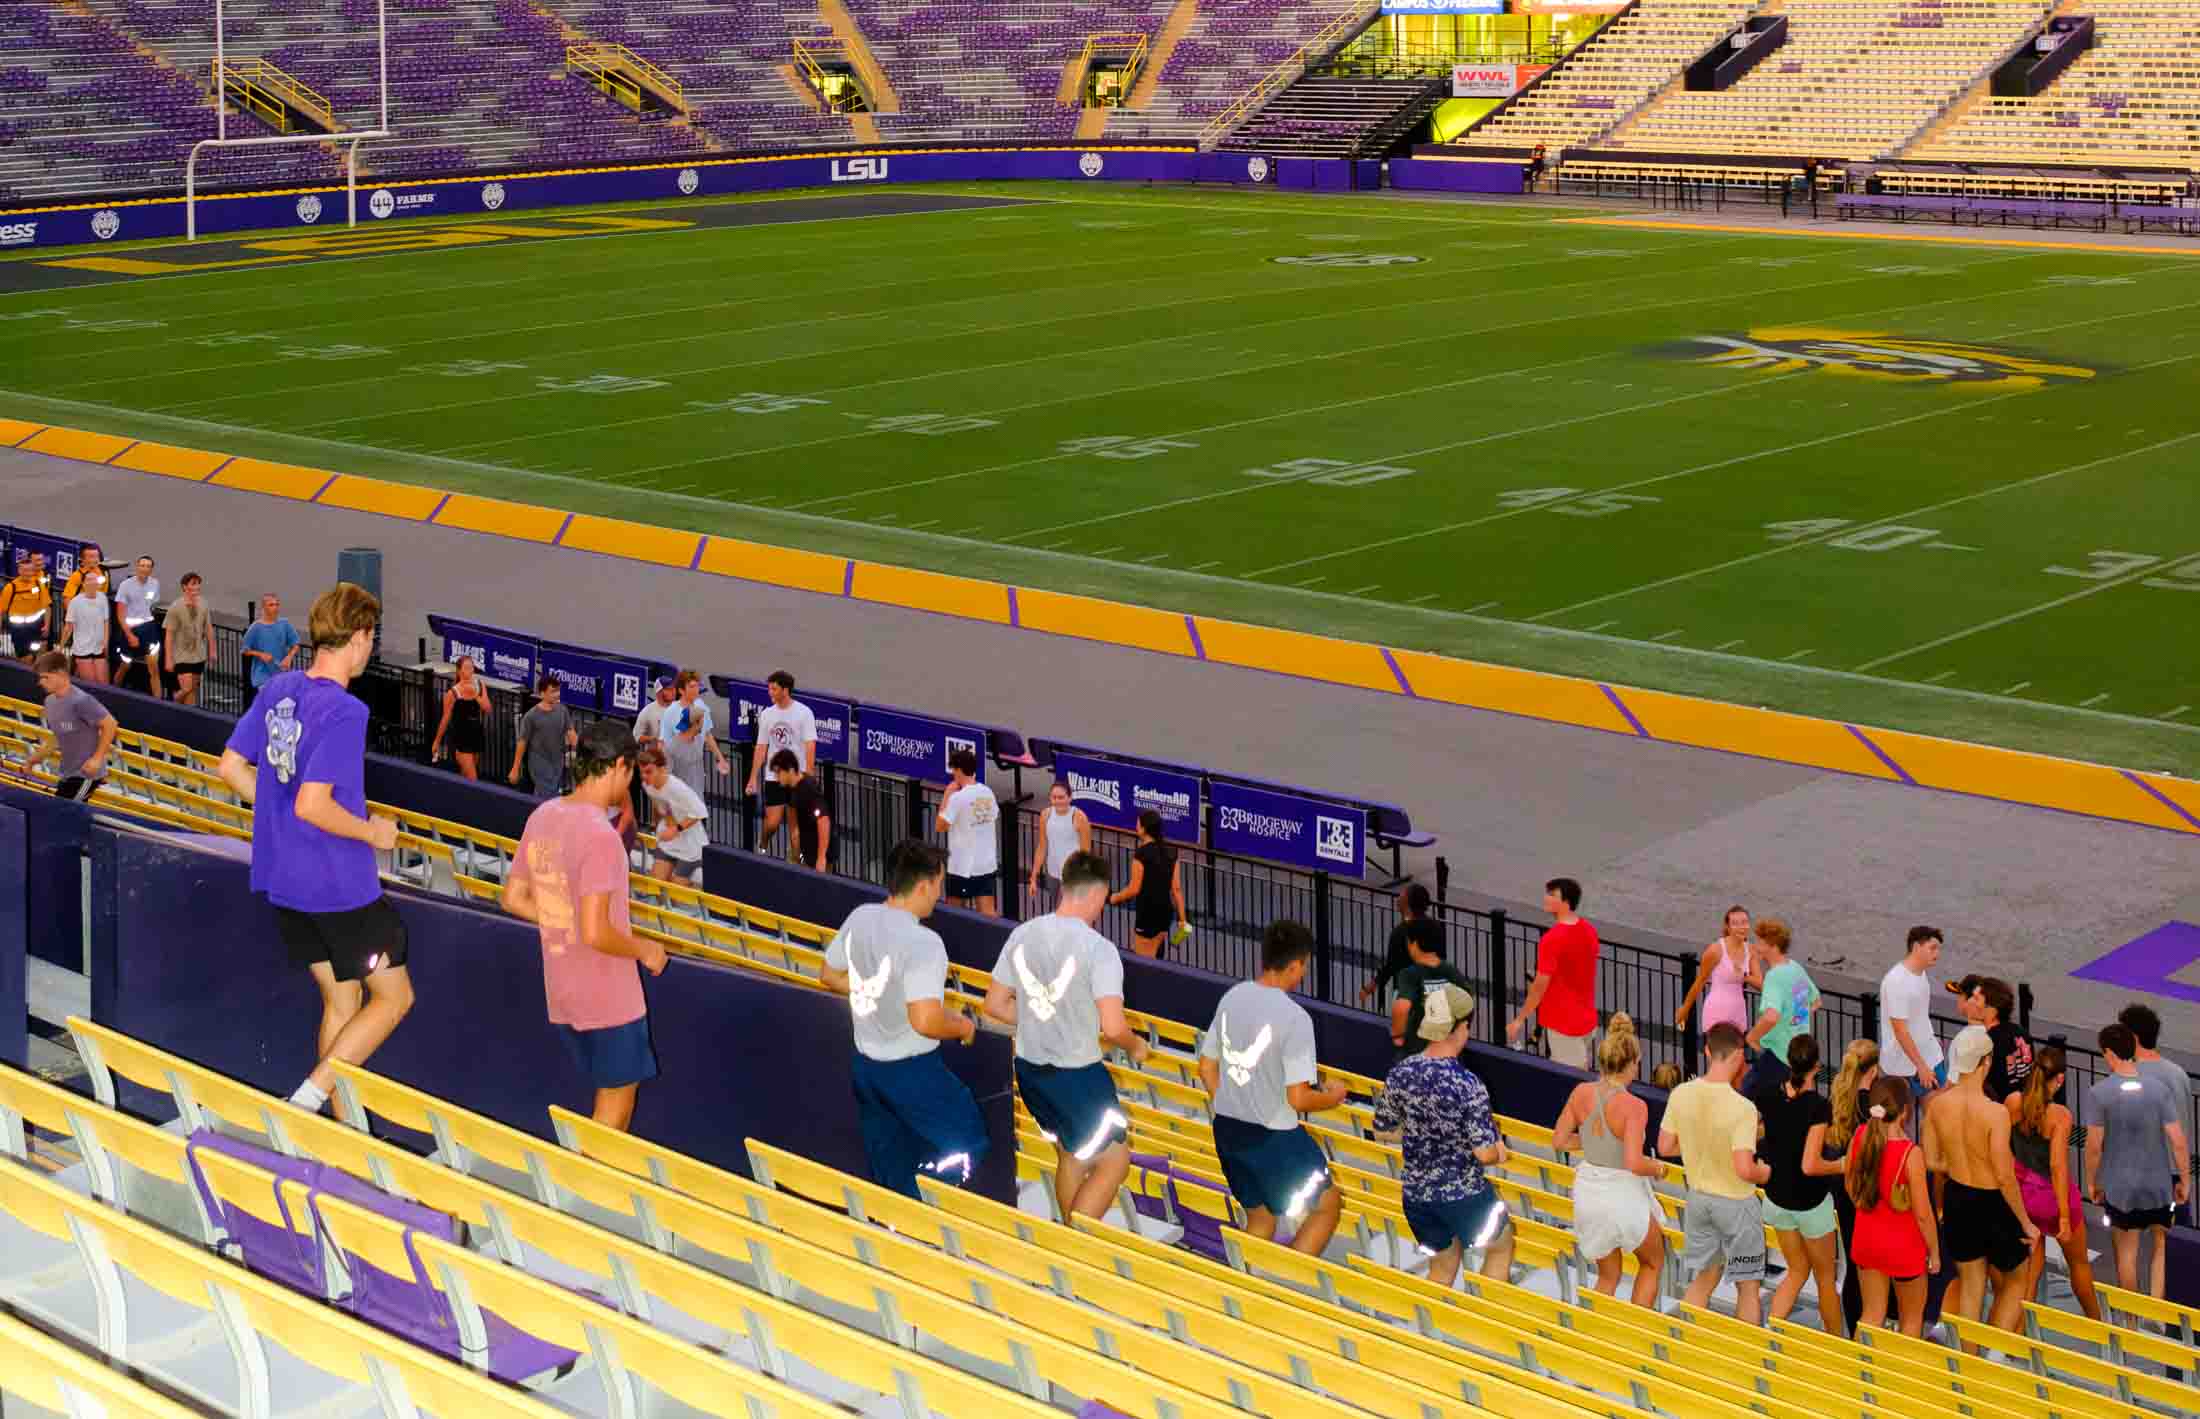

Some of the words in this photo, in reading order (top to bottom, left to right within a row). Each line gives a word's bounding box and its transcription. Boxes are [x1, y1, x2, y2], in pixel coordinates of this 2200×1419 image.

[831, 158, 888, 181] LSU
[373, 197, 392, 212] 44
[0, 222, 38, 240] ess
[1056, 434, 1201, 459] 45
[1241, 457, 1416, 487] 50
[1495, 487, 1664, 517] 45
[1761, 517, 1942, 552] 40
[881, 732, 935, 754] BRIDGEWAY
[890, 744, 924, 760] HOSPICE
[1133, 784, 1190, 808] SouthernAIR
[1238, 808, 1304, 835] BRIDGEWAY
[1249, 825, 1291, 841] HOSPICE
